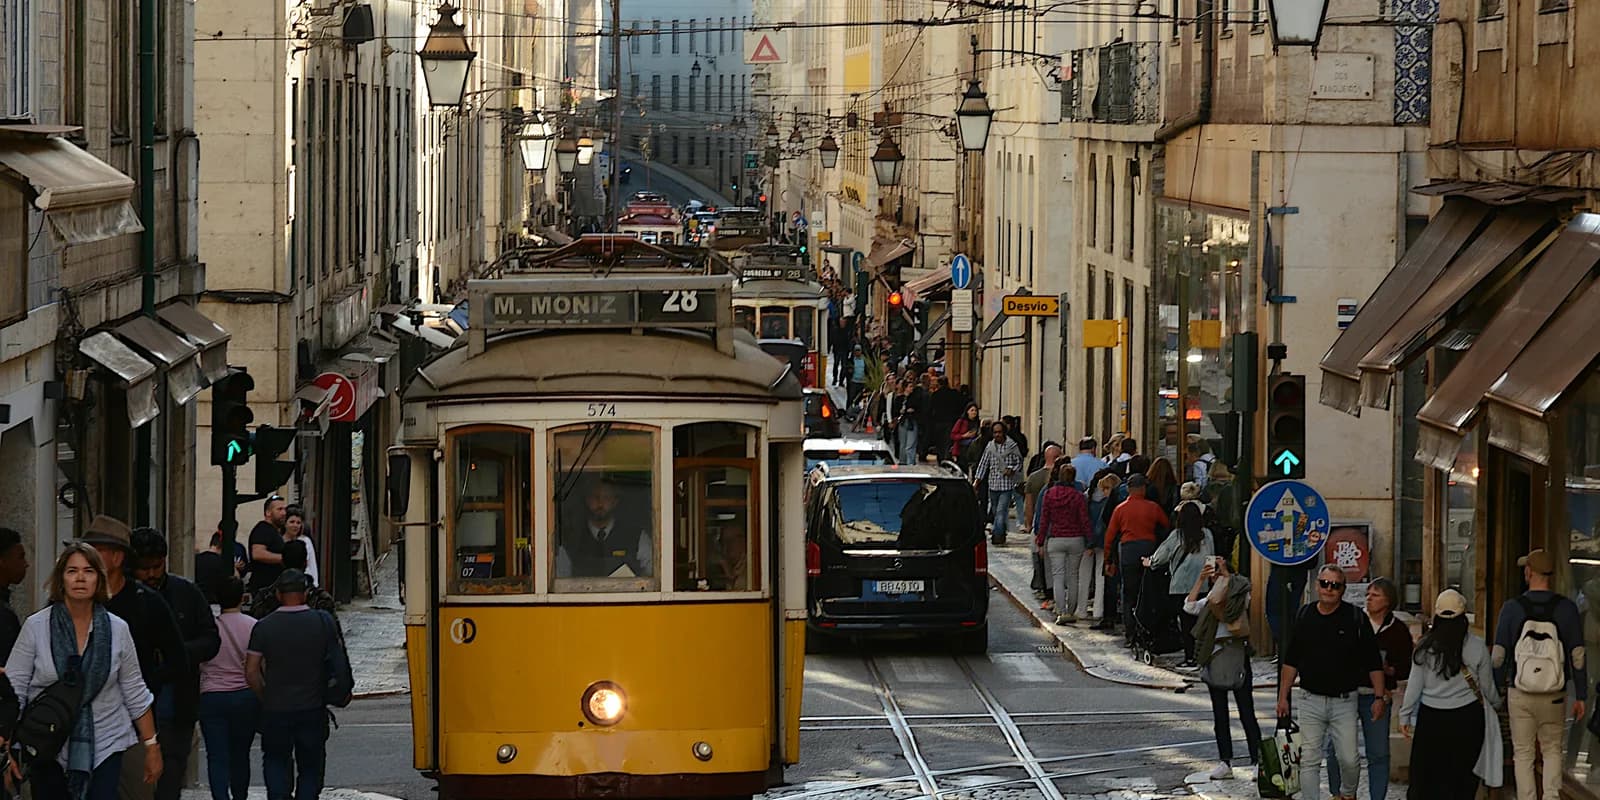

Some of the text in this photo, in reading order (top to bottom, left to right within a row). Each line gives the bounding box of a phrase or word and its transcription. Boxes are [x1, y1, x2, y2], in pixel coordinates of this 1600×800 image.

[788, 269, 801, 279] 28
[494, 291, 698, 315] M. MONIZ 28
[1007, 300, 1048, 312] Desvio
[588, 403, 616, 417] 574
[462, 567, 474, 577] 07
